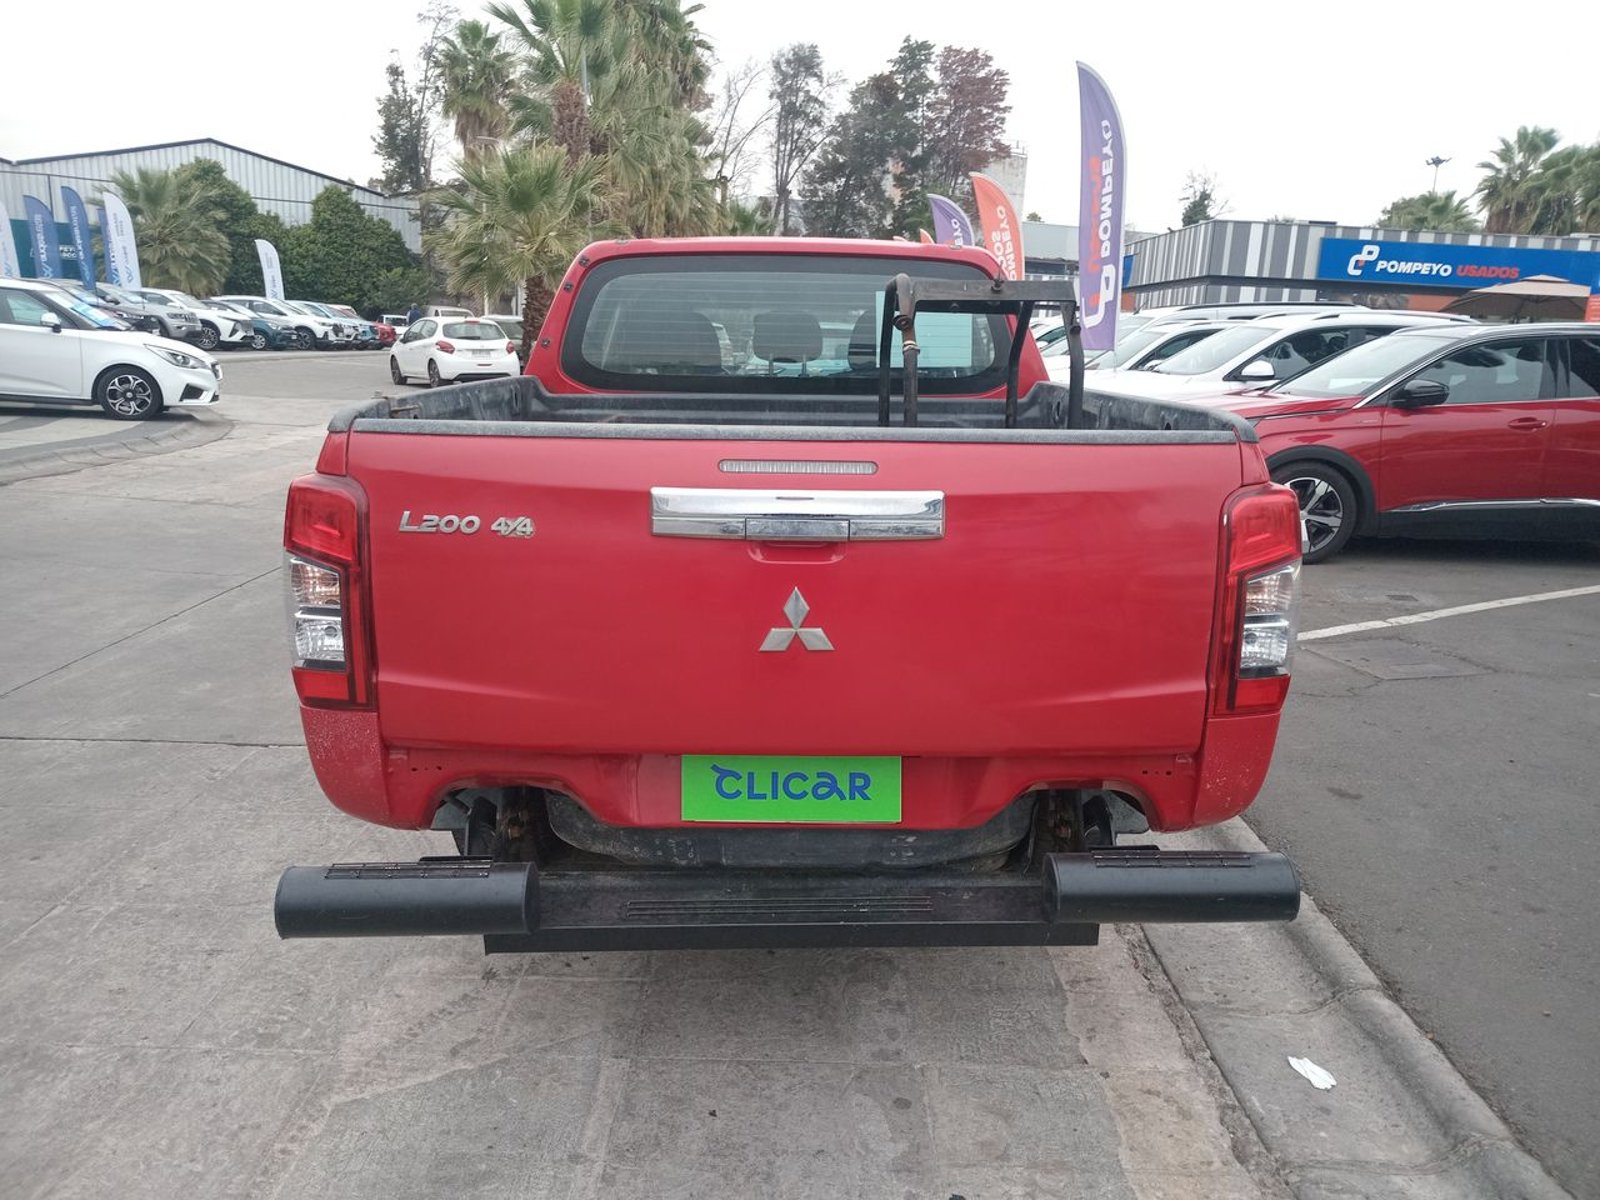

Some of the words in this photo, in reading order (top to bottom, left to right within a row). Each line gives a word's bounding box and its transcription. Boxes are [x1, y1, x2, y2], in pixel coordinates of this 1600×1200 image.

[1376, 260, 1453, 277] POMPEYO
[1456, 264, 1520, 279] USADOS
[399, 510, 481, 535] L200
